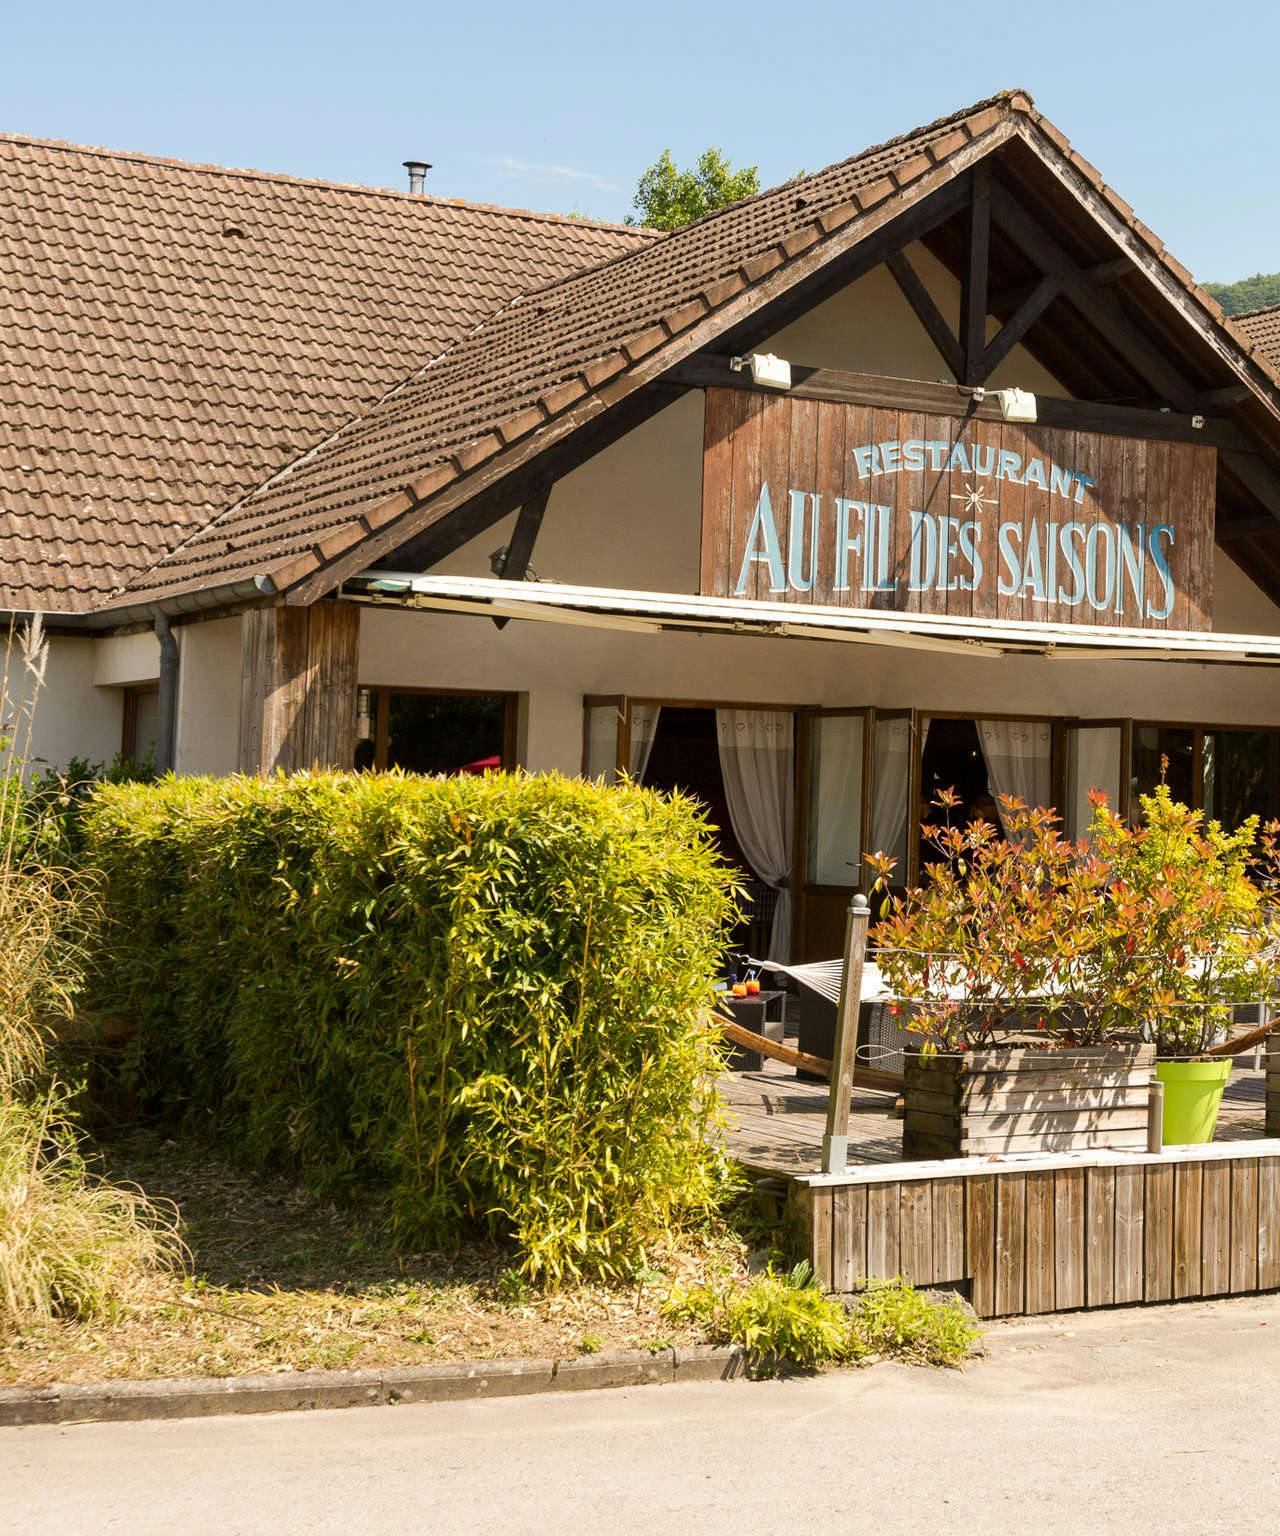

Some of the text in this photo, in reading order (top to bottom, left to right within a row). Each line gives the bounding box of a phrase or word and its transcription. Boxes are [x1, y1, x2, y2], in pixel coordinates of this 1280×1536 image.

[853, 439, 1096, 504] RESTAURANT
[734, 481, 1175, 620] AU FIL DES SAISONS
